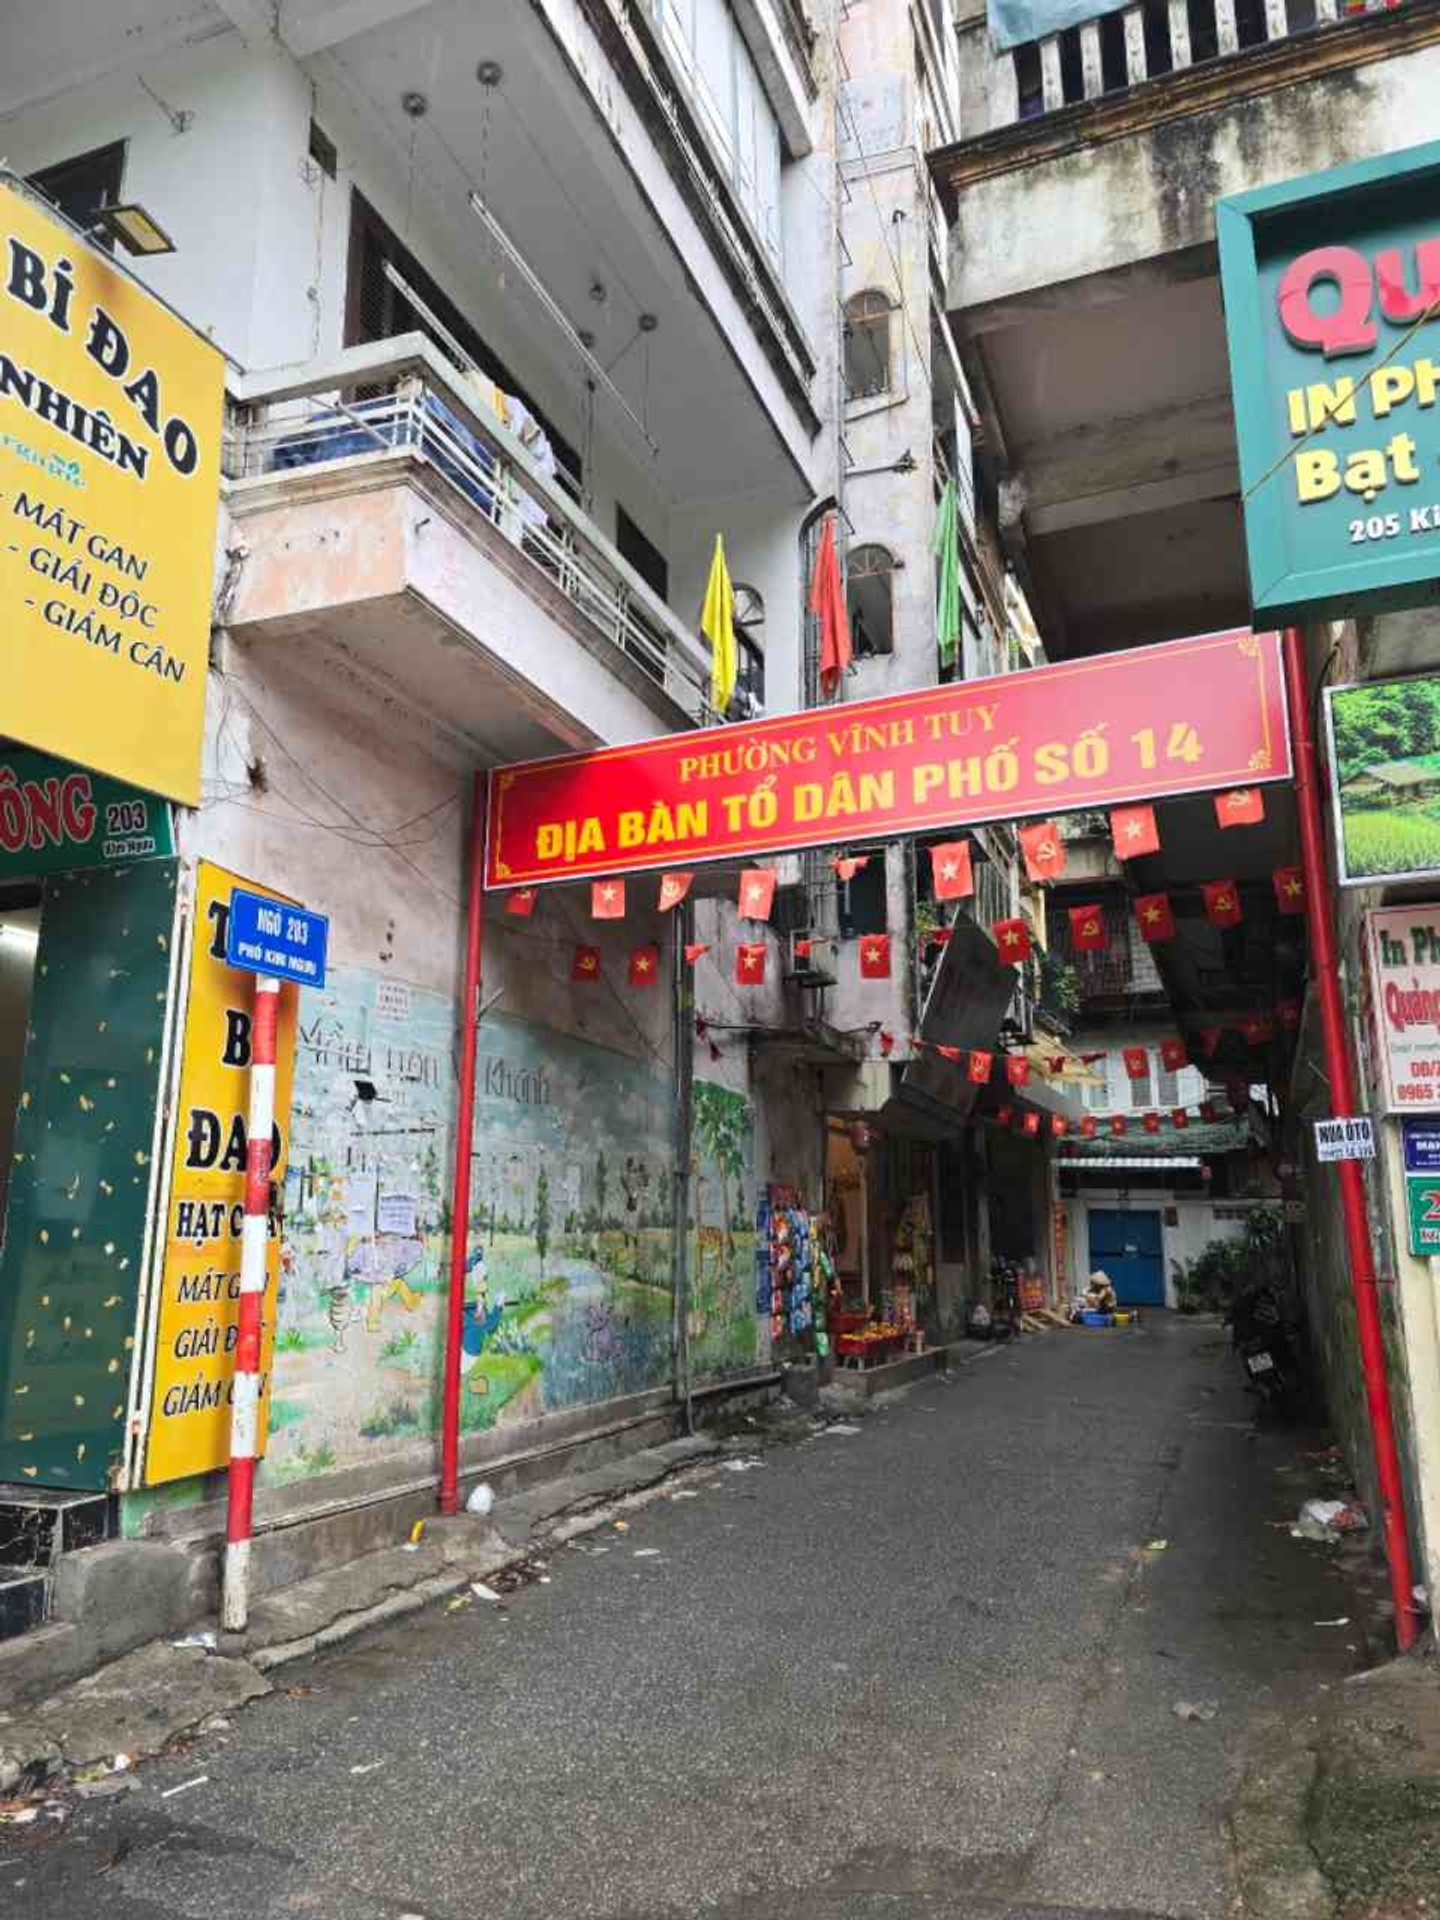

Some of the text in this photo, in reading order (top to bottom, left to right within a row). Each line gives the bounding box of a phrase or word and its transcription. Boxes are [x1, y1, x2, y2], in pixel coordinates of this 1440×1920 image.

[6, 238, 75, 331] BÍ
[1288, 377, 1357, 437] IN
[1296, 432, 1420, 505] Bạt
[13, 492, 148, 581] MÁT GAN
[1350, 512, 1400, 545] 205
[98, 582, 158, 628] ĐỘC
[679, 703, 999, 784] PHƯỜNG VĨNH TUY
[106, 800, 146, 835] 203
[535, 720, 1203, 862] ĐỊA BÀN TỔ DÂN PHỐ SỐ 14
[176, 1202, 225, 1247] HẠT
[178, 1267, 227, 1304] MÁT
[162, 1371, 222, 1418] GIẢM
